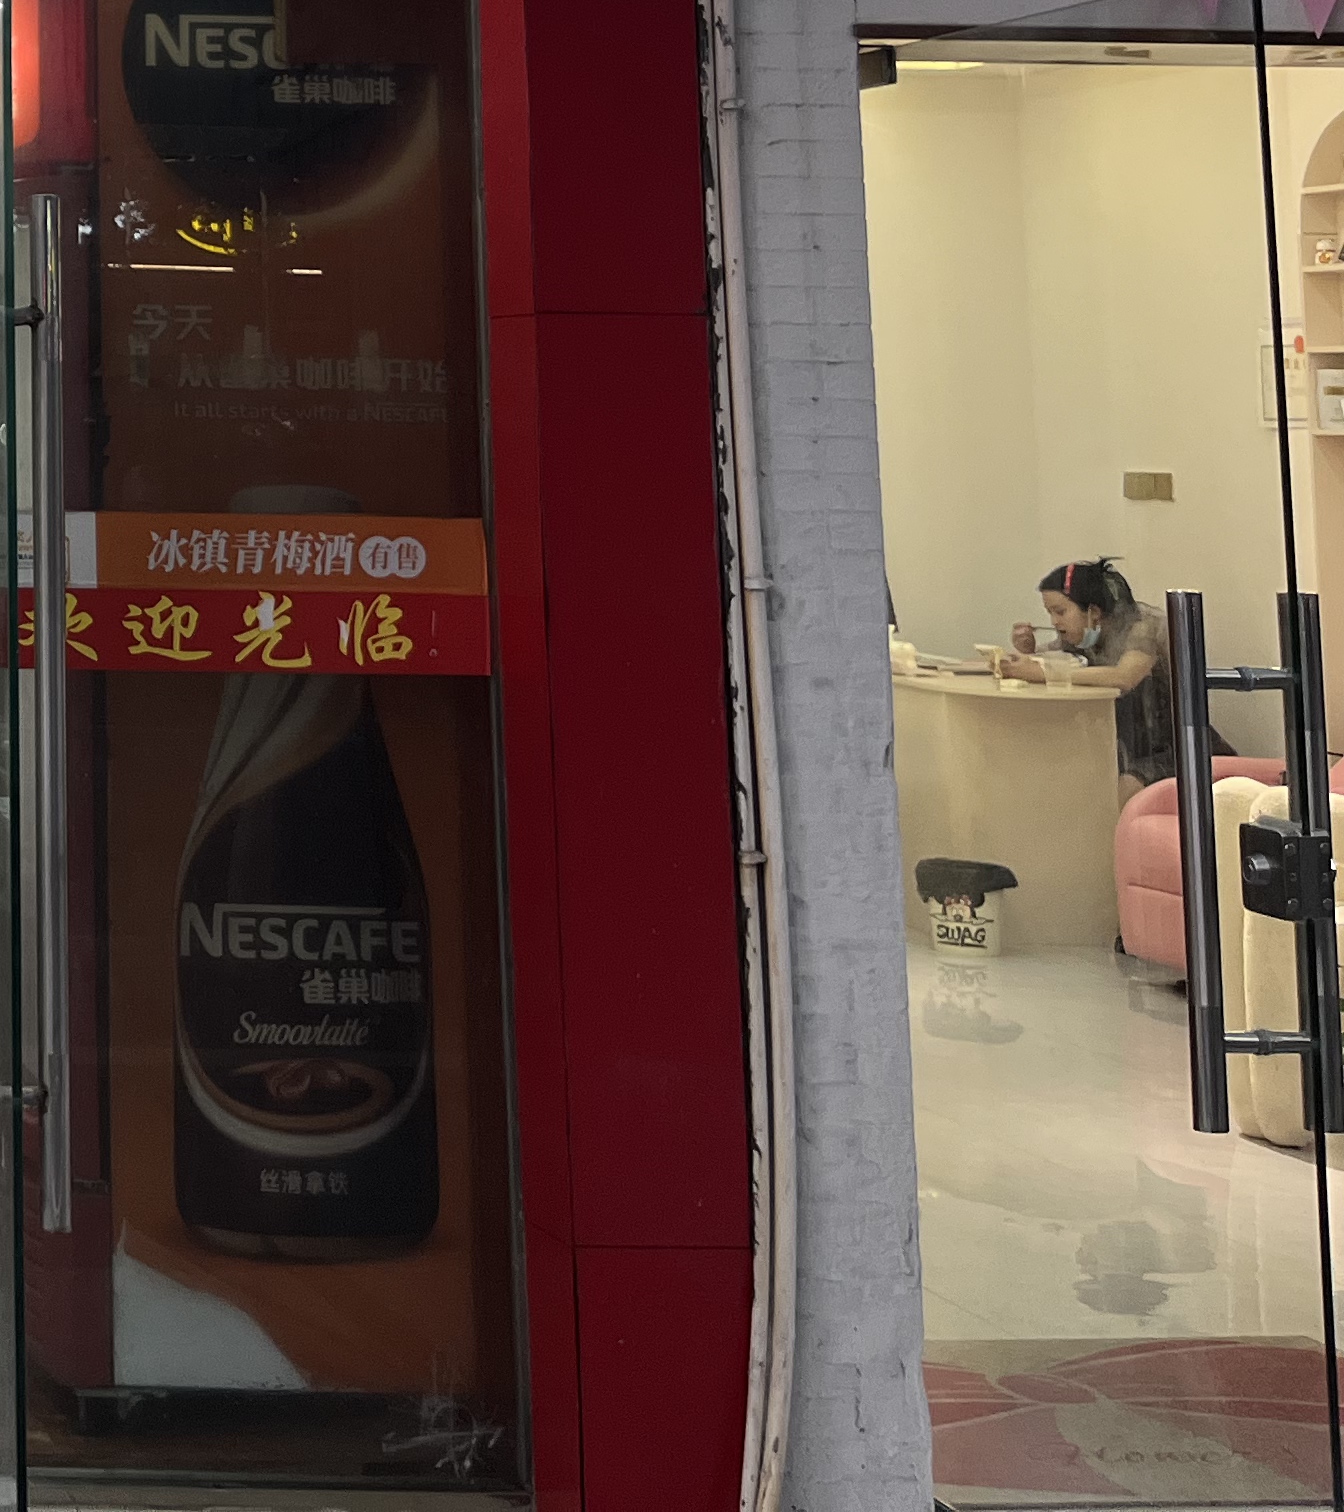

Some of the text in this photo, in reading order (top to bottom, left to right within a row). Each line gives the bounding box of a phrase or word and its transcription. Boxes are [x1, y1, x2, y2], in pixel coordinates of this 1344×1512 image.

[270, 74, 397, 106] 雀巢咖啡
[145, 529, 355, 576] 冰镇青梅酒
[179, 901, 422, 963] NESCAFE
[299, 967, 422, 1005] 雀巢咖啡
